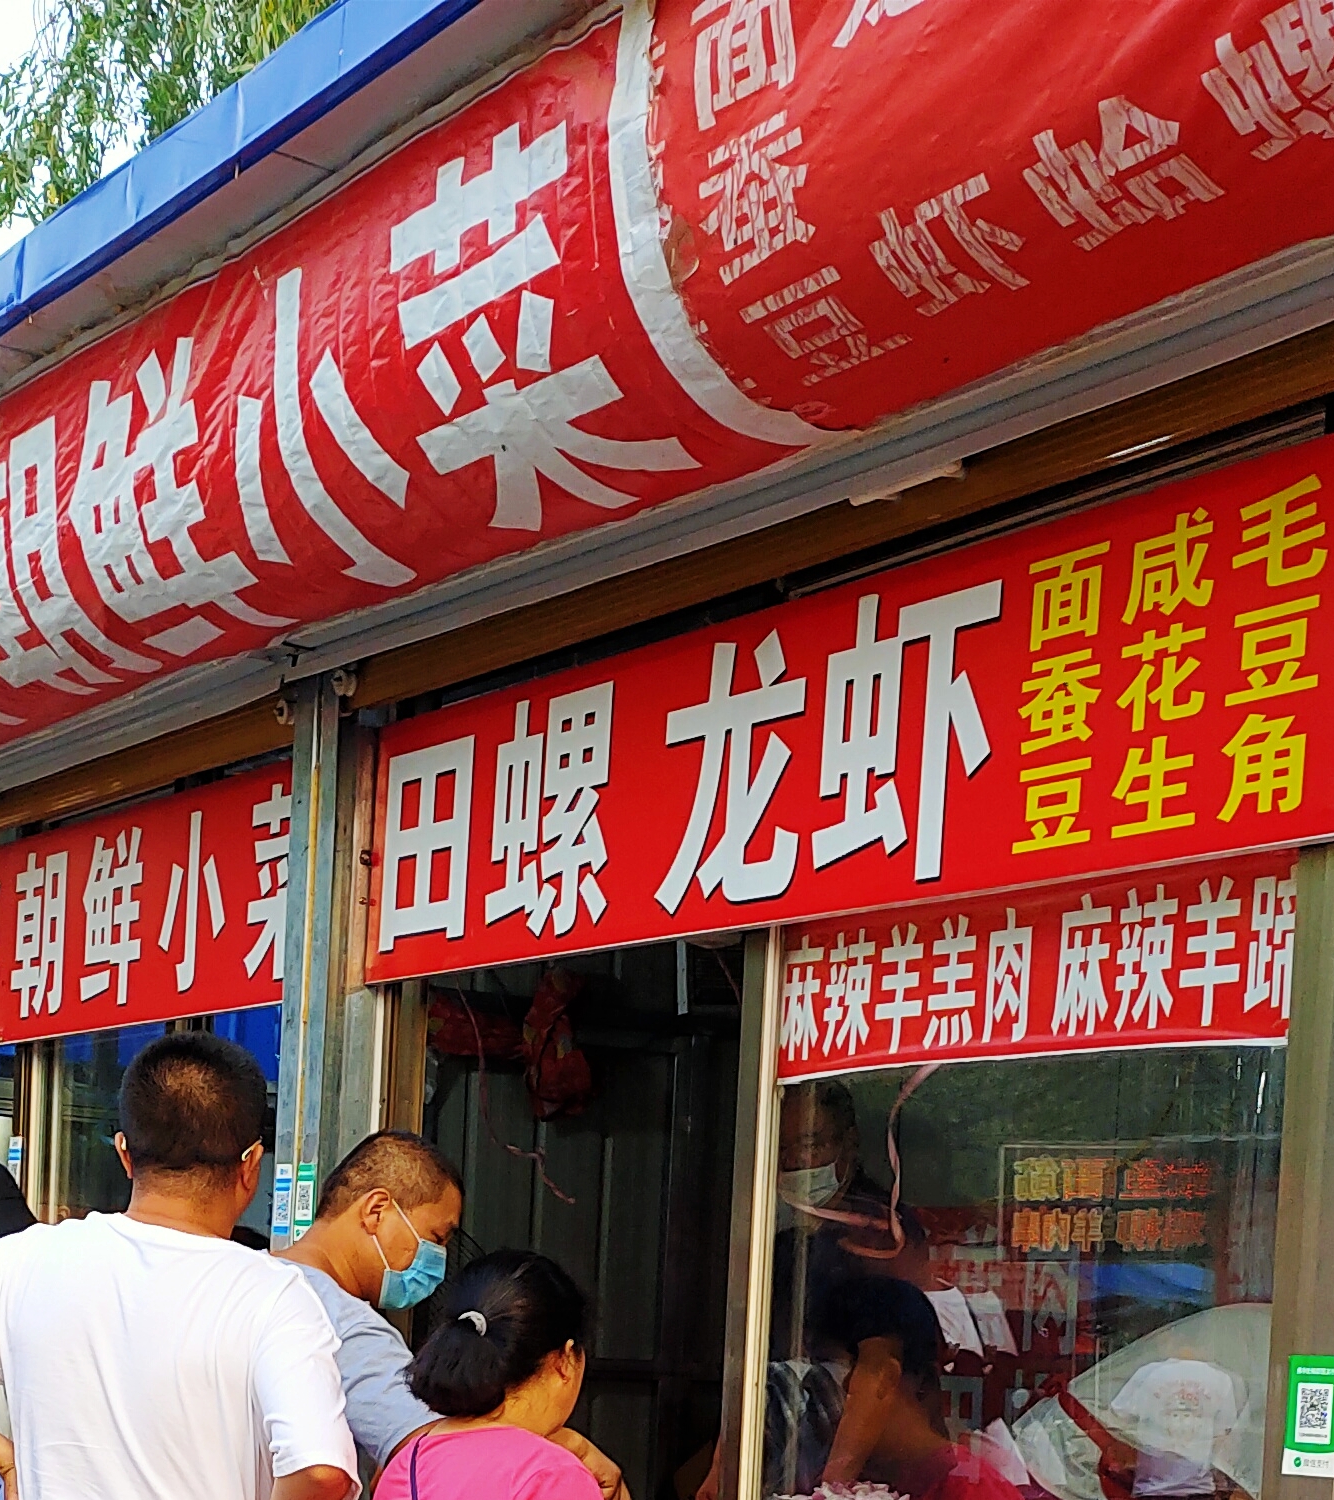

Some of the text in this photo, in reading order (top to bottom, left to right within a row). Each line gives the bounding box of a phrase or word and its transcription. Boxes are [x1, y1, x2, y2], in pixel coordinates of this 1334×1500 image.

[377, 580, 1002, 952] 田螺 龙虾
[1011, 540, 1111, 855] 面蚕豆
[1110, 507, 1215, 840] 咸花生
[1215, 473, 1327, 824] 毛豆角
[780, 907, 1033, 1062] 麻辣羊羔肉
